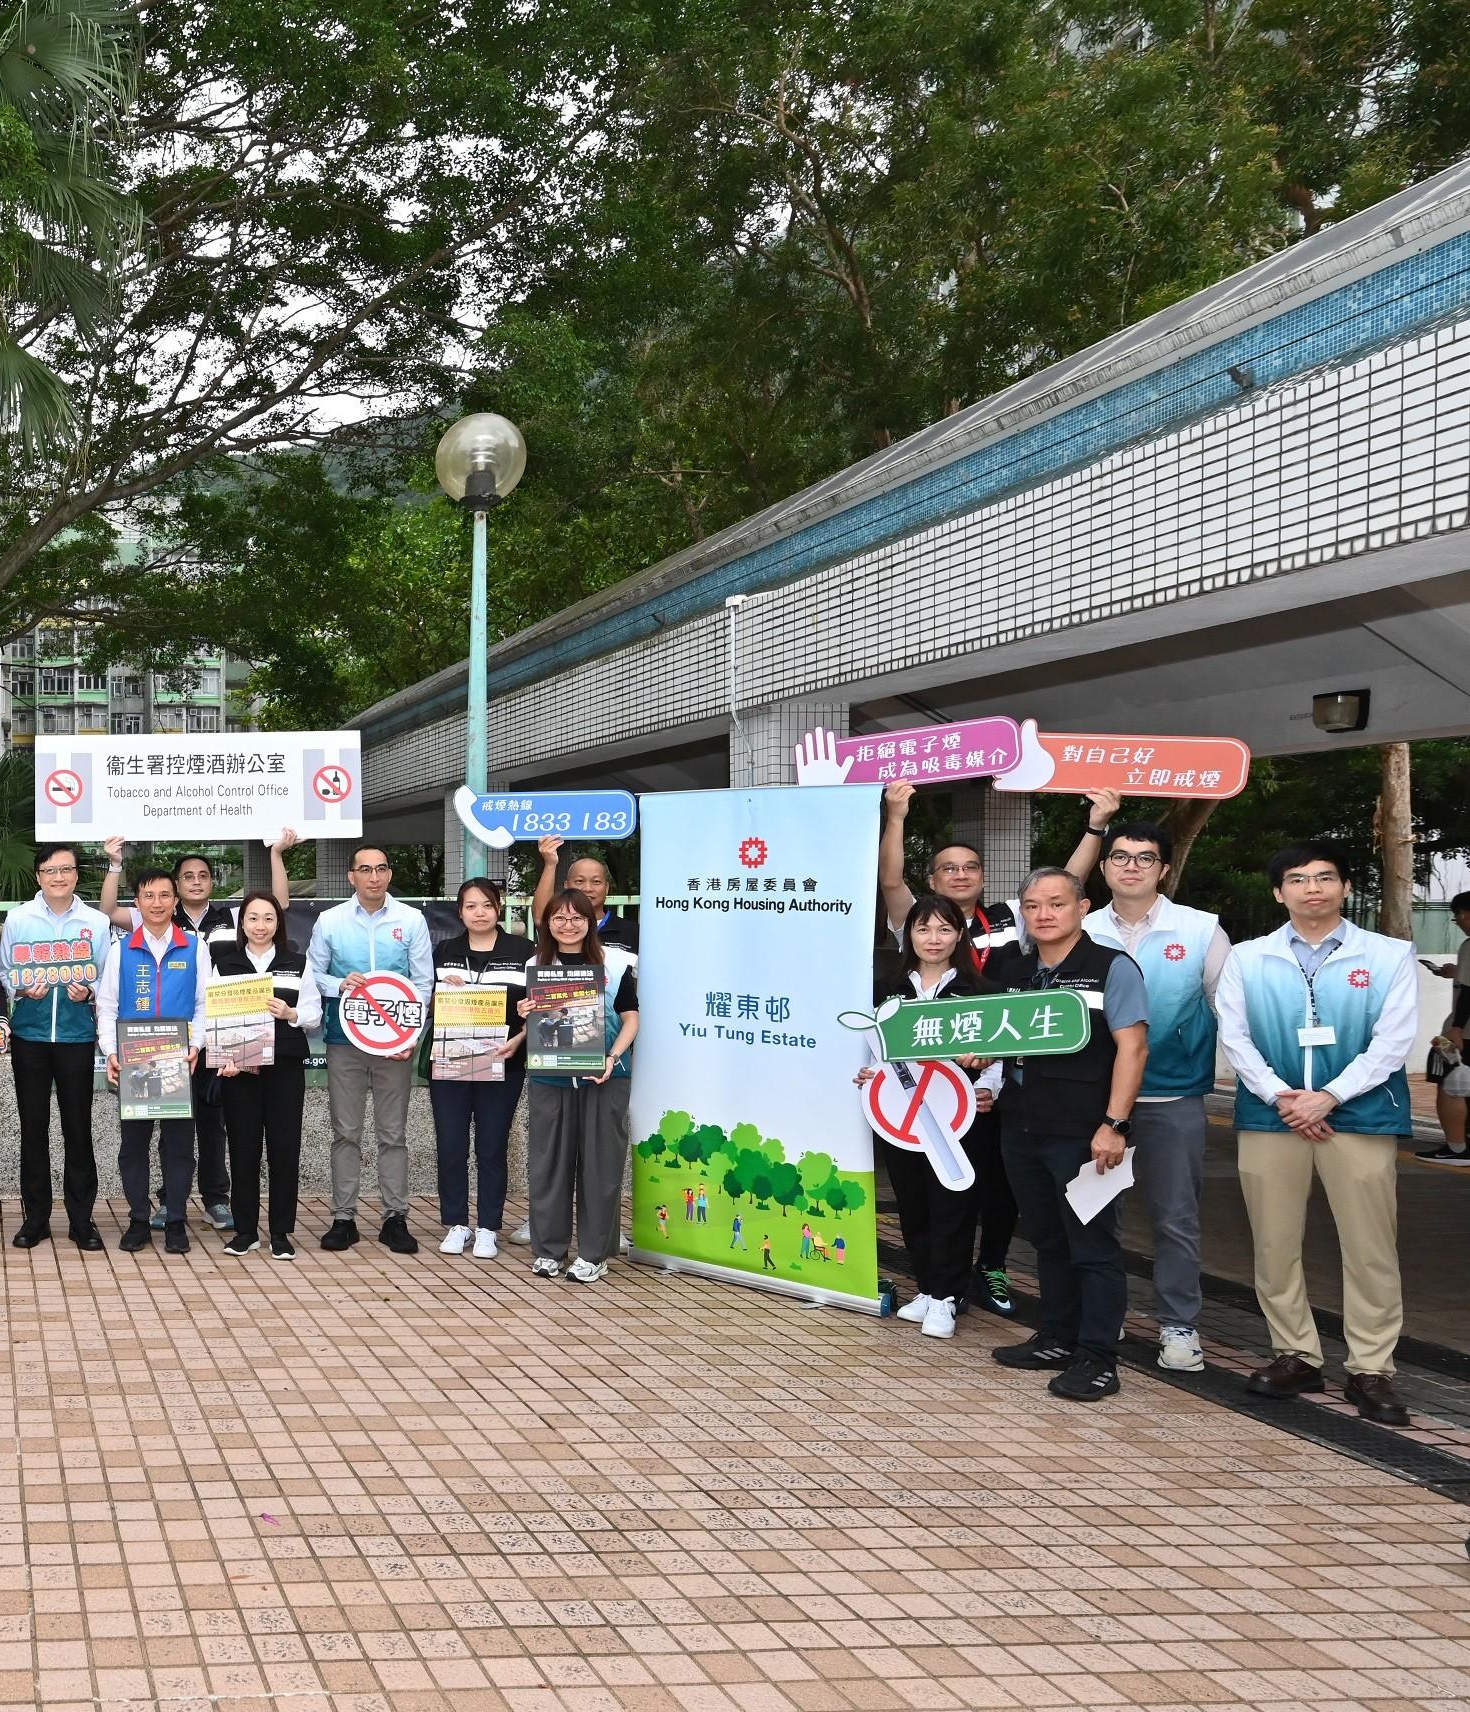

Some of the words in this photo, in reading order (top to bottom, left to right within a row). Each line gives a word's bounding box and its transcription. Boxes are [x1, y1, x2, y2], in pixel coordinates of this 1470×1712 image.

[856, 732, 962, 762] 拒絕電子煙
[1061, 745, 1155, 764] 對自己好
[878, 748, 1009, 779] 成為吸毒媒介
[1125, 770, 1223, 788] 立即戒煙
[107, 787, 149, 798] Tobacco
[154, 786, 172, 798] and
[176, 785, 213, 797] Alcohol
[217, 785, 254, 796] Control
[258, 785, 289, 796] Office
[143, 804, 202, 818] Department
[206, 804, 217, 816] of
[220, 804, 253, 816] Health
[481, 799, 533, 811] 戒煙熱線
[512, 812, 571, 832] 1833
[582, 811, 627, 831] 183
[687, 877, 818, 892] 香港房屋委員會
[655, 897, 689, 911] Hong
[693, 897, 730, 912] Kong
[733, 898, 785, 913] Housing
[788, 899, 852, 915] Authority
[13, 941, 91, 964] 舉報熱線
[9, 964, 97, 987] 1828080
[344, 997, 422, 1029] 電子煙
[706, 992, 791, 1023] 耀東邨
[679, 1023, 707, 1038] Yiu
[714, 1025, 755, 1045] Tung
[761, 1030, 817, 1048] Estate
[911, 1005, 1063, 1047] 無煙人生
